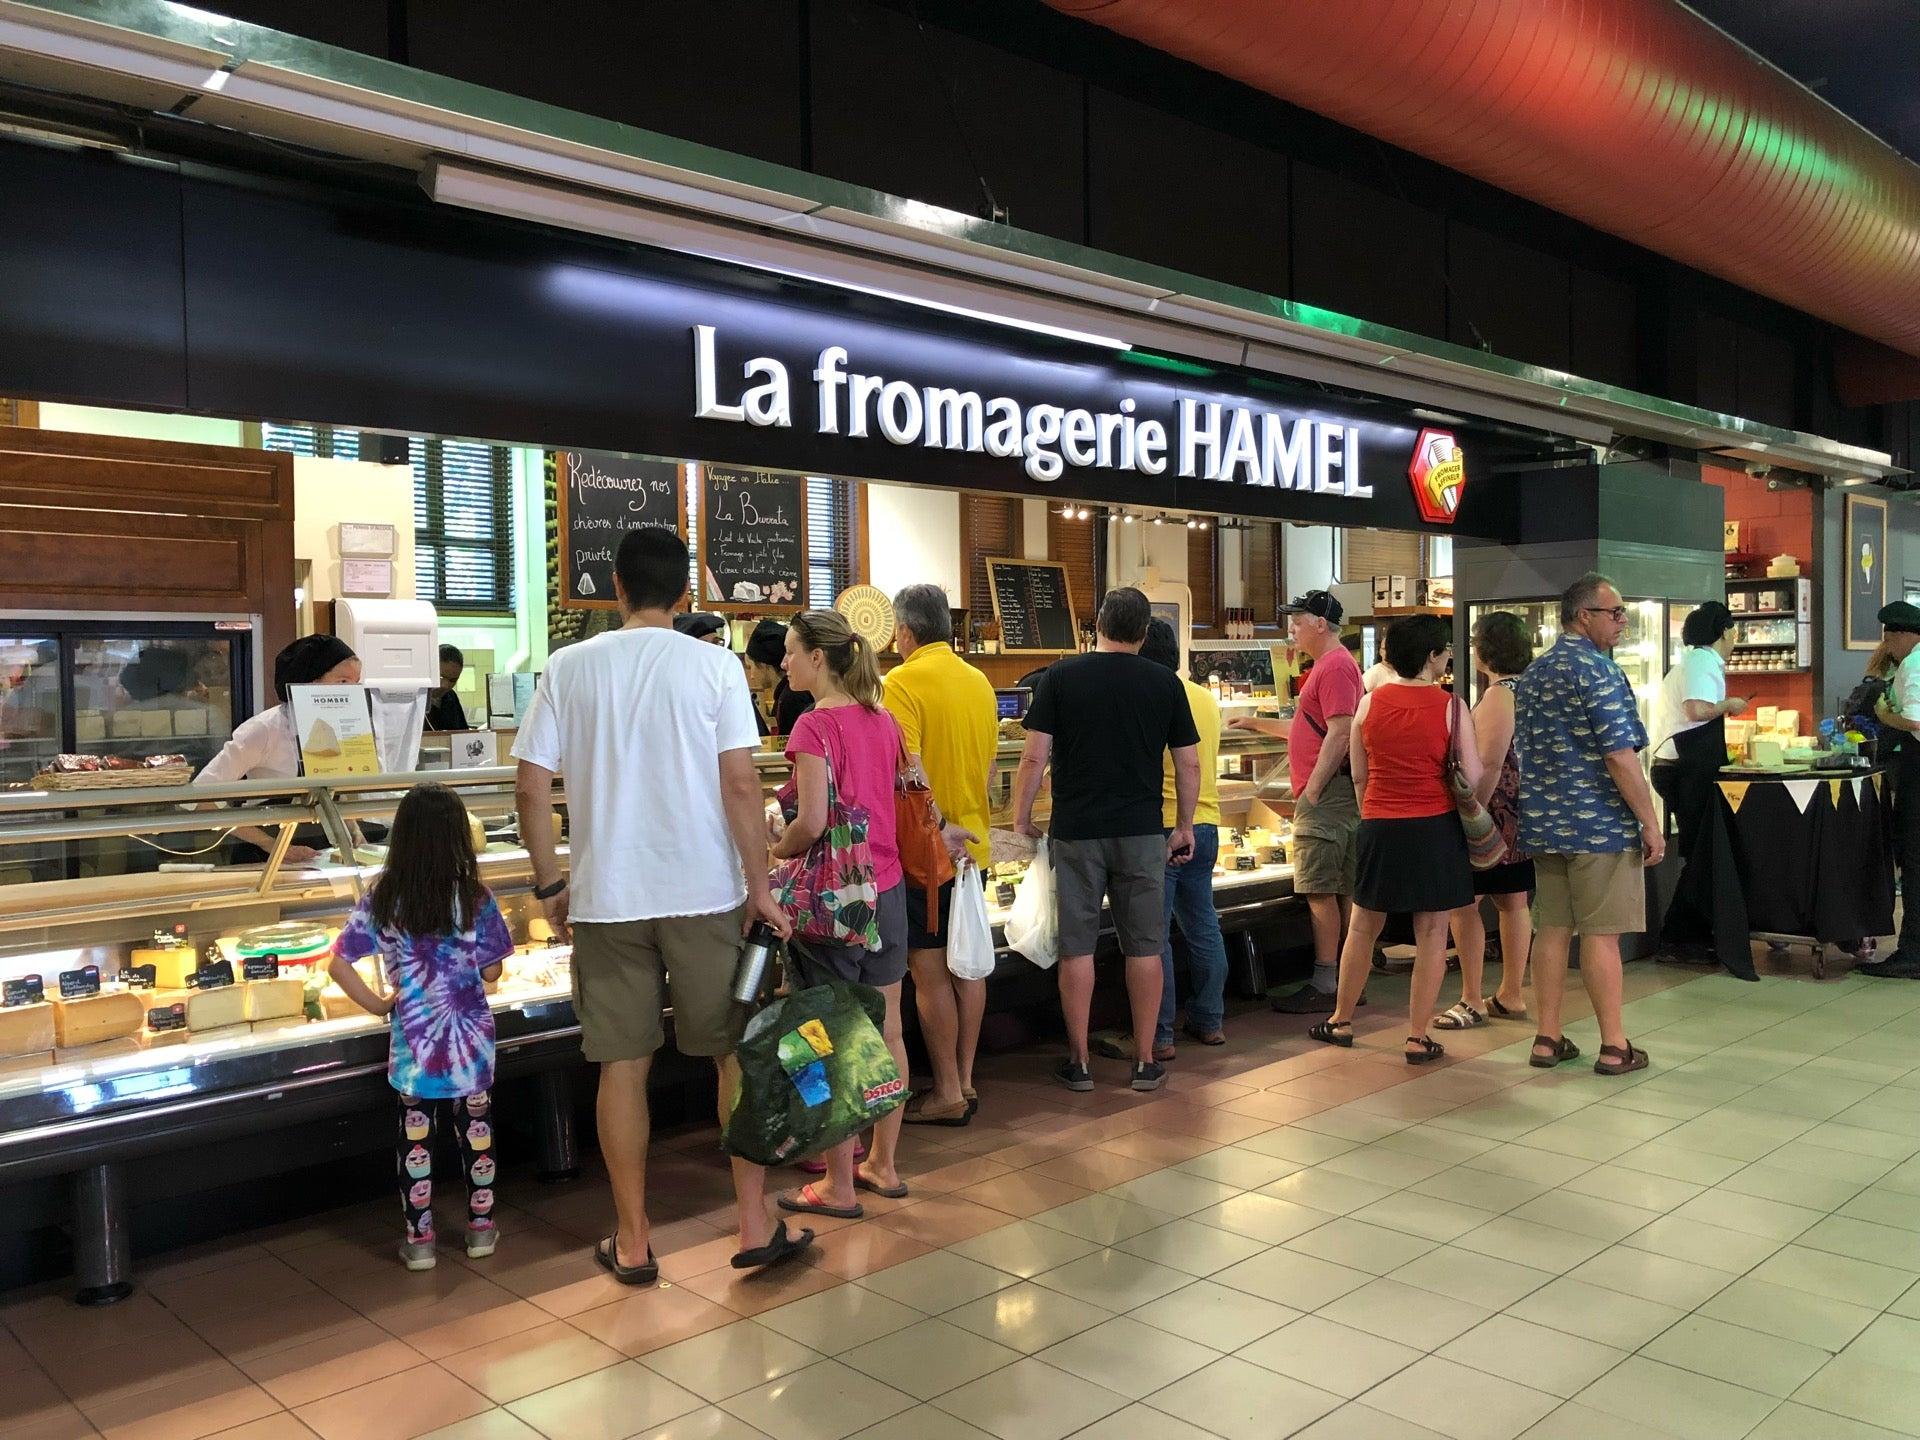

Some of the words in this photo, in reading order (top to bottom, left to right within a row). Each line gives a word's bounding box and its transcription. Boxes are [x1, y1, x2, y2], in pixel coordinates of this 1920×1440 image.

[693, 325, 792, 428] La
[812, 346, 1168, 483] fromagerie
[1175, 398, 1373, 499] HAMEL
[1434, 464, 1461, 482] FROMAGER
[1437, 473, 1460, 490] AFFINEUR
[650, 480, 671, 495] nos
[715, 494, 734, 521] La
[739, 491, 790, 526] Burrata
[572, 512, 612, 531] chèvres
[575, 546, 613, 571] privée
